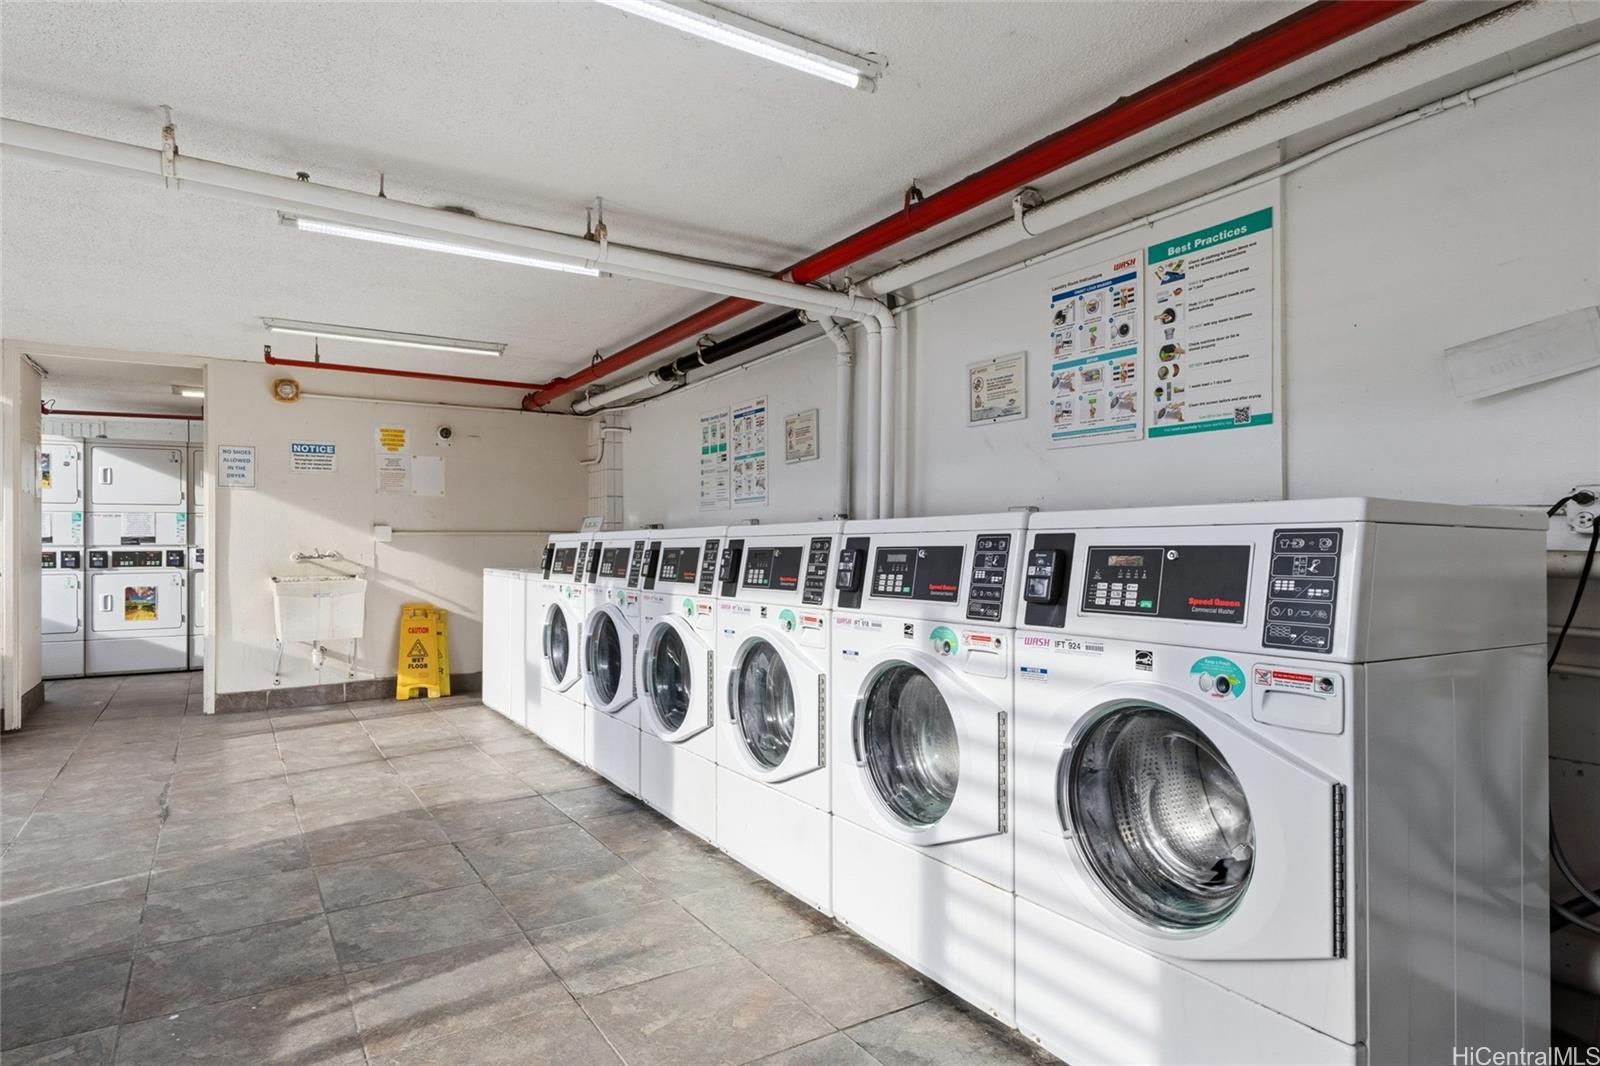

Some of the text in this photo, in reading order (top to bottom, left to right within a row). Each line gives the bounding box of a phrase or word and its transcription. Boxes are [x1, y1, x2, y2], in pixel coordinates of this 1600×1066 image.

[1168, 226, 1247, 256] Best Practices
[1114, 258, 1136, 271] WASH
[293, 444, 334, 453] NOTICE
[1214, 598, 1240, 606] Queen
[1024, 637, 1050, 647] WASH
